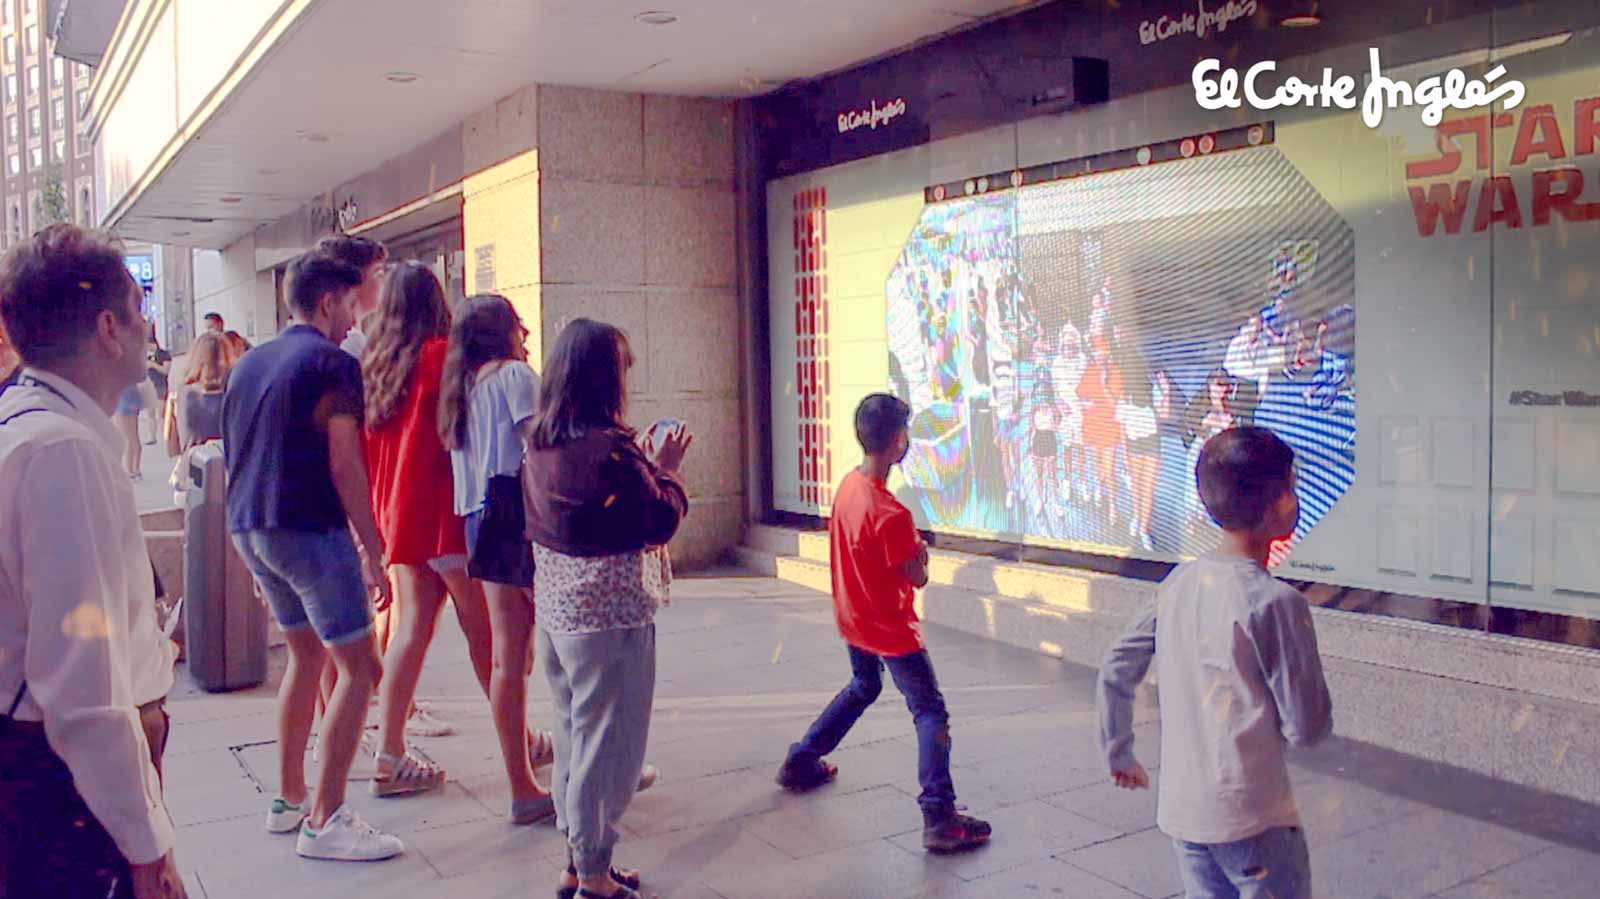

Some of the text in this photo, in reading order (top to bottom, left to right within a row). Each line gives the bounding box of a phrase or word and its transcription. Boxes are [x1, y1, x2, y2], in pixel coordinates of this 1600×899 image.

[1138, 21, 1156, 45] El
[1156, 15, 1196, 40] Corte
[1408, 168, 1600, 238] WAR
